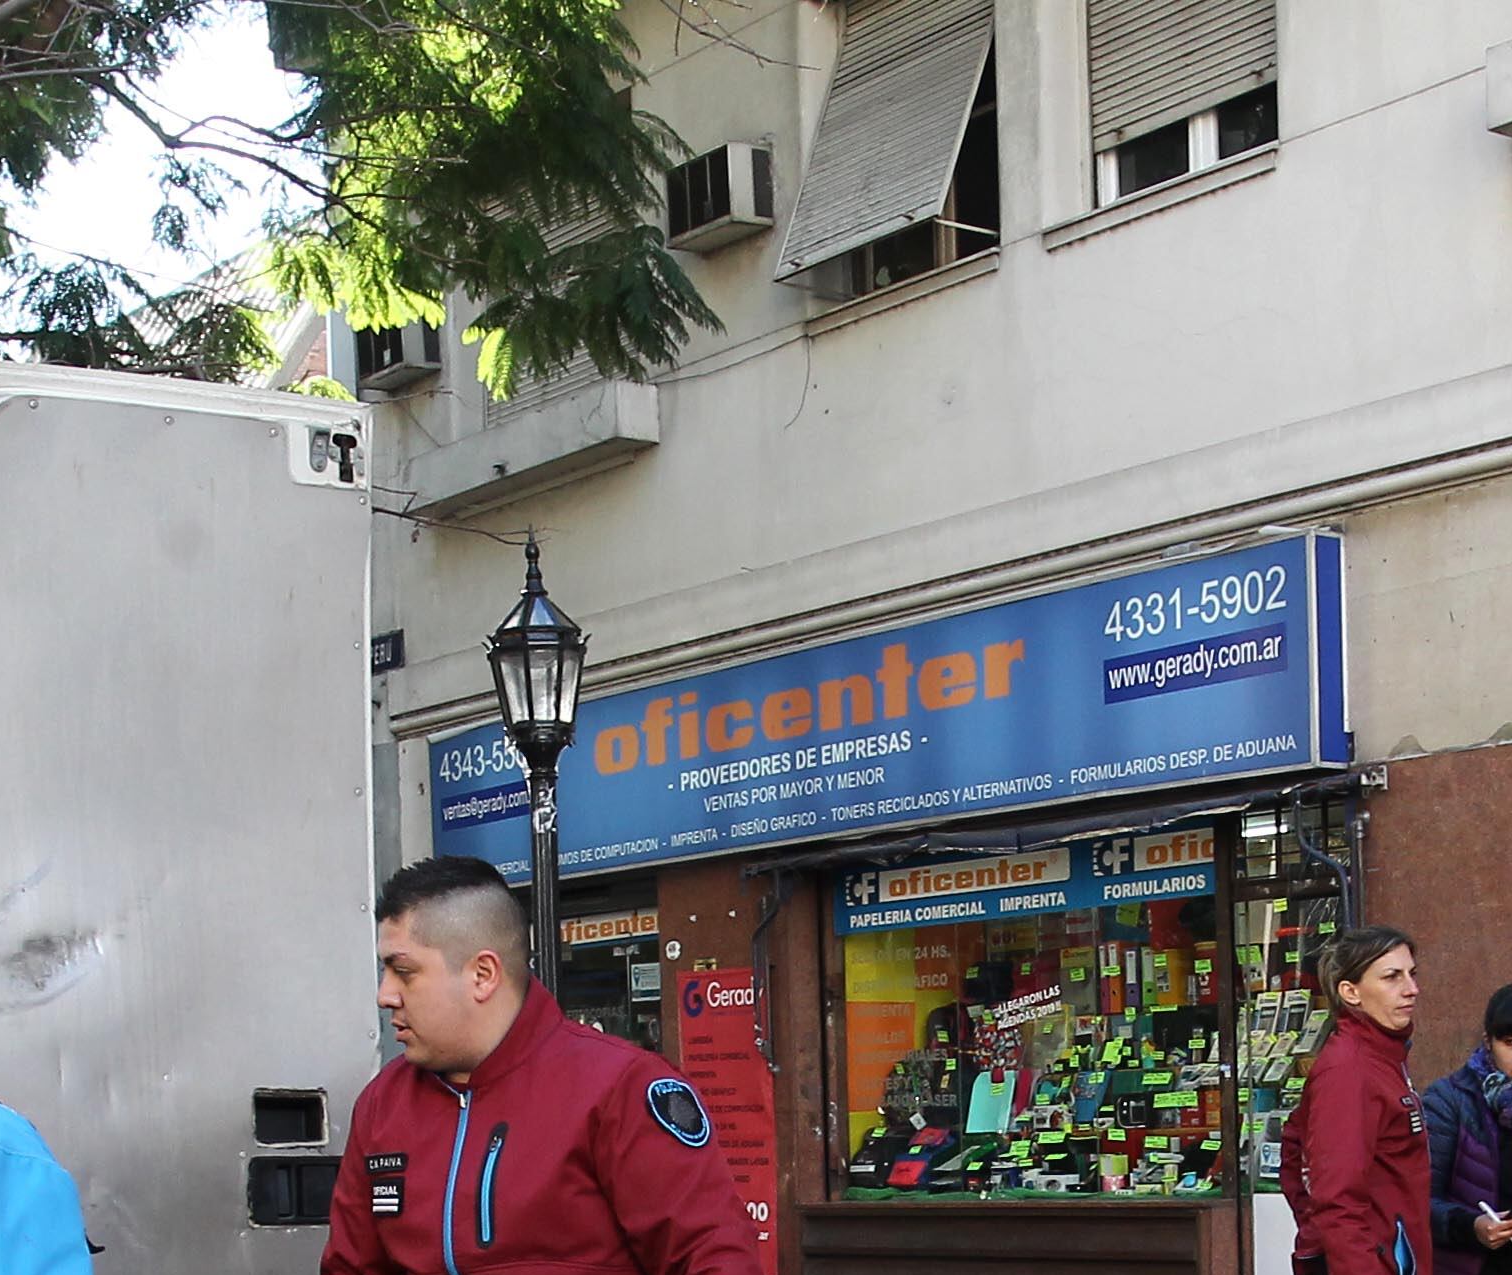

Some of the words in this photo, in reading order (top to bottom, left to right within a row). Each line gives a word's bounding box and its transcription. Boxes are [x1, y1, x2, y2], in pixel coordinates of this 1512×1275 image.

[1104, 565, 1287, 642] 4331-5902
[1108, 634, 1283, 689] www.gerady.com.ar
[594, 639, 1025, 776] oficenter
[439, 740, 524, 783] 4343-55
[680, 752, 791, 792] PROVEEDORES
[796, 746, 817, 770] DE
[821, 730, 912, 766] EMPRESAS
[498, 859, 530, 875] MERCIAL
[581, 850, 594, 863] DE
[594, 838, 659, 860] COMPUTACION
[670, 828, 718, 847] IMPRENTA
[731, 818, 769, 838] DISEÑO
[770, 810, 817, 833] GRAFICO
[831, 802, 875, 822] TONERS
[878, 790, 951, 816] RECICLADOS
[952, 788, 961, 803] Y
[962, 774, 1053, 802] ALTERNATIVOS
[1070, 755, 1167, 785] FORMULARIOS
[1169, 748, 1209, 770] DESP.
[1212, 744, 1233, 763] DE
[1236, 734, 1297, 758] ADUANA
[703, 792, 749, 812] VENTAS
[751, 787, 777, 806] POR
[780, 777, 823, 801] MAYOR
[825, 775, 835, 794] Y
[837, 767, 885, 791] MENOR
[889, 858, 1048, 896] oficenter
[1104, 874, 1206, 899] FORMULARIOS
[562, 912, 658, 943] ficente
[850, 908, 913, 929] PAPELERIA
[915, 902, 986, 922] COMERCIAL
[1000, 892, 1066, 912] IMPRENTA
[915, 946, 928, 960] 24
[706, 981, 764, 1008] Gerad
[1043, 984, 1061, 999] LAS
